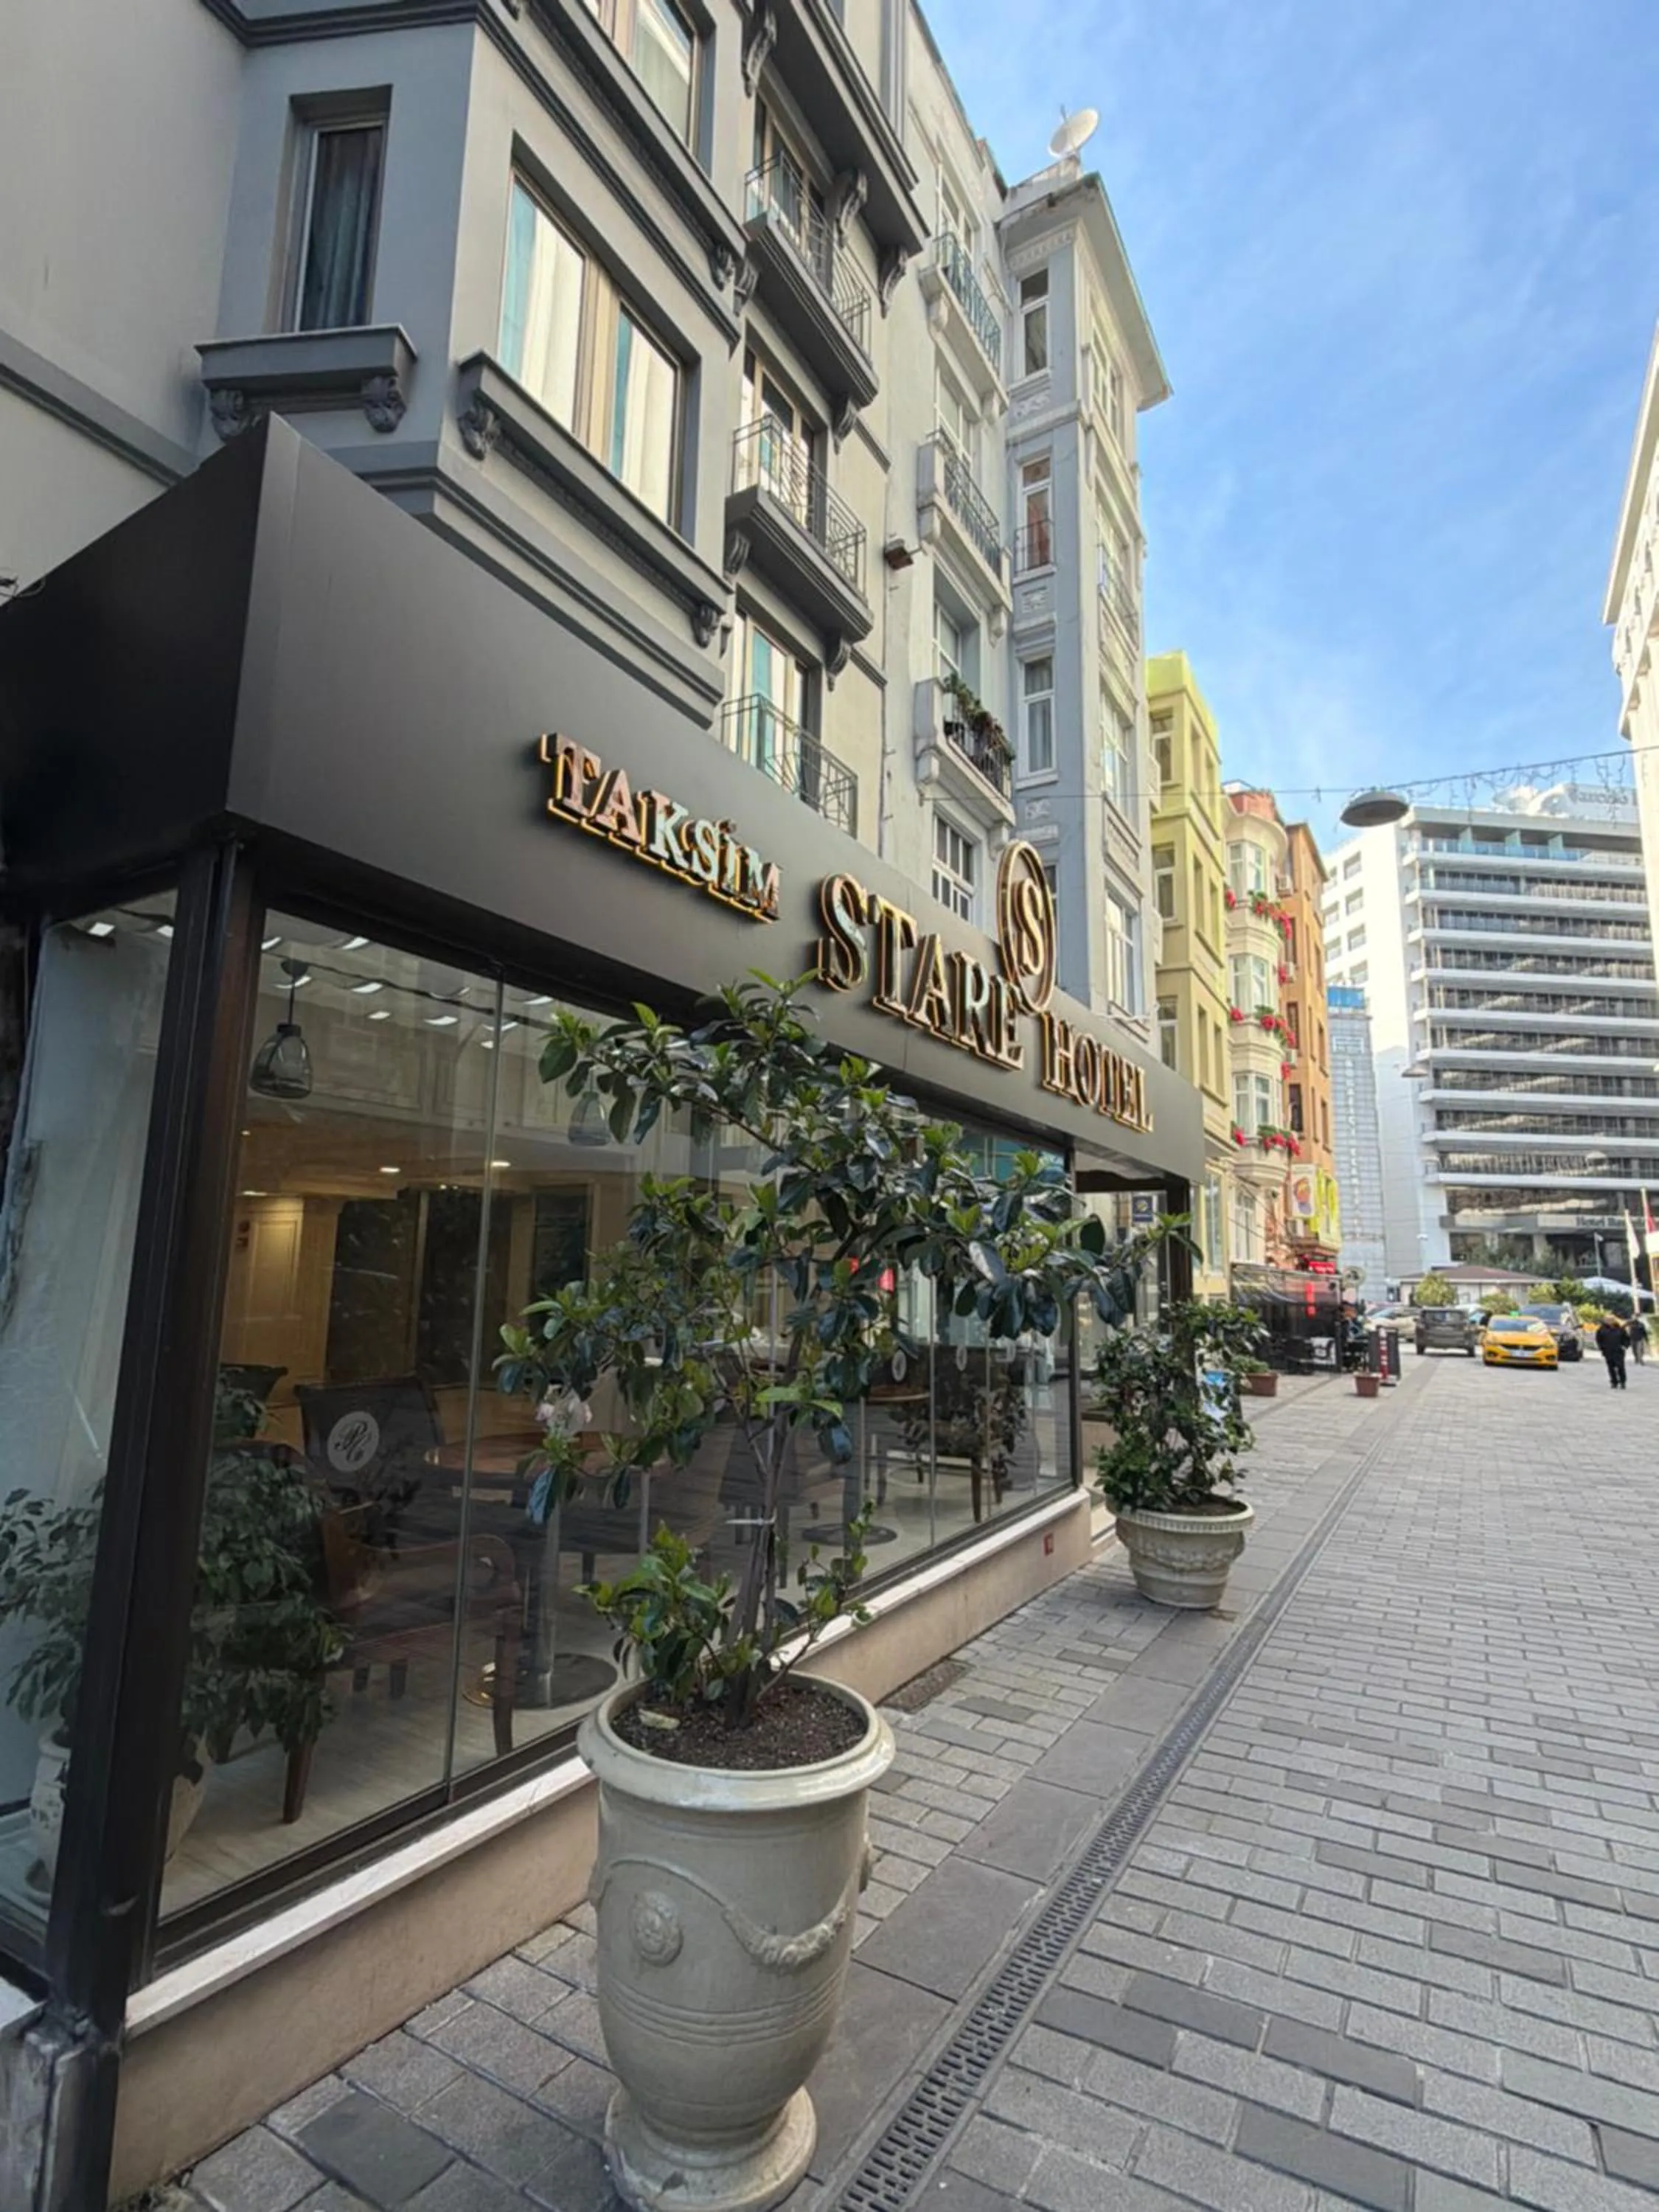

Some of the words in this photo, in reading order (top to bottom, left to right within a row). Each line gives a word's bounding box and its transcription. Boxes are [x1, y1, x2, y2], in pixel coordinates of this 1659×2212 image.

[816, 872, 1024, 1071] STARE
[1040, 1011, 1155, 1133] HOTEL
[1012, 877, 1045, 976] S
